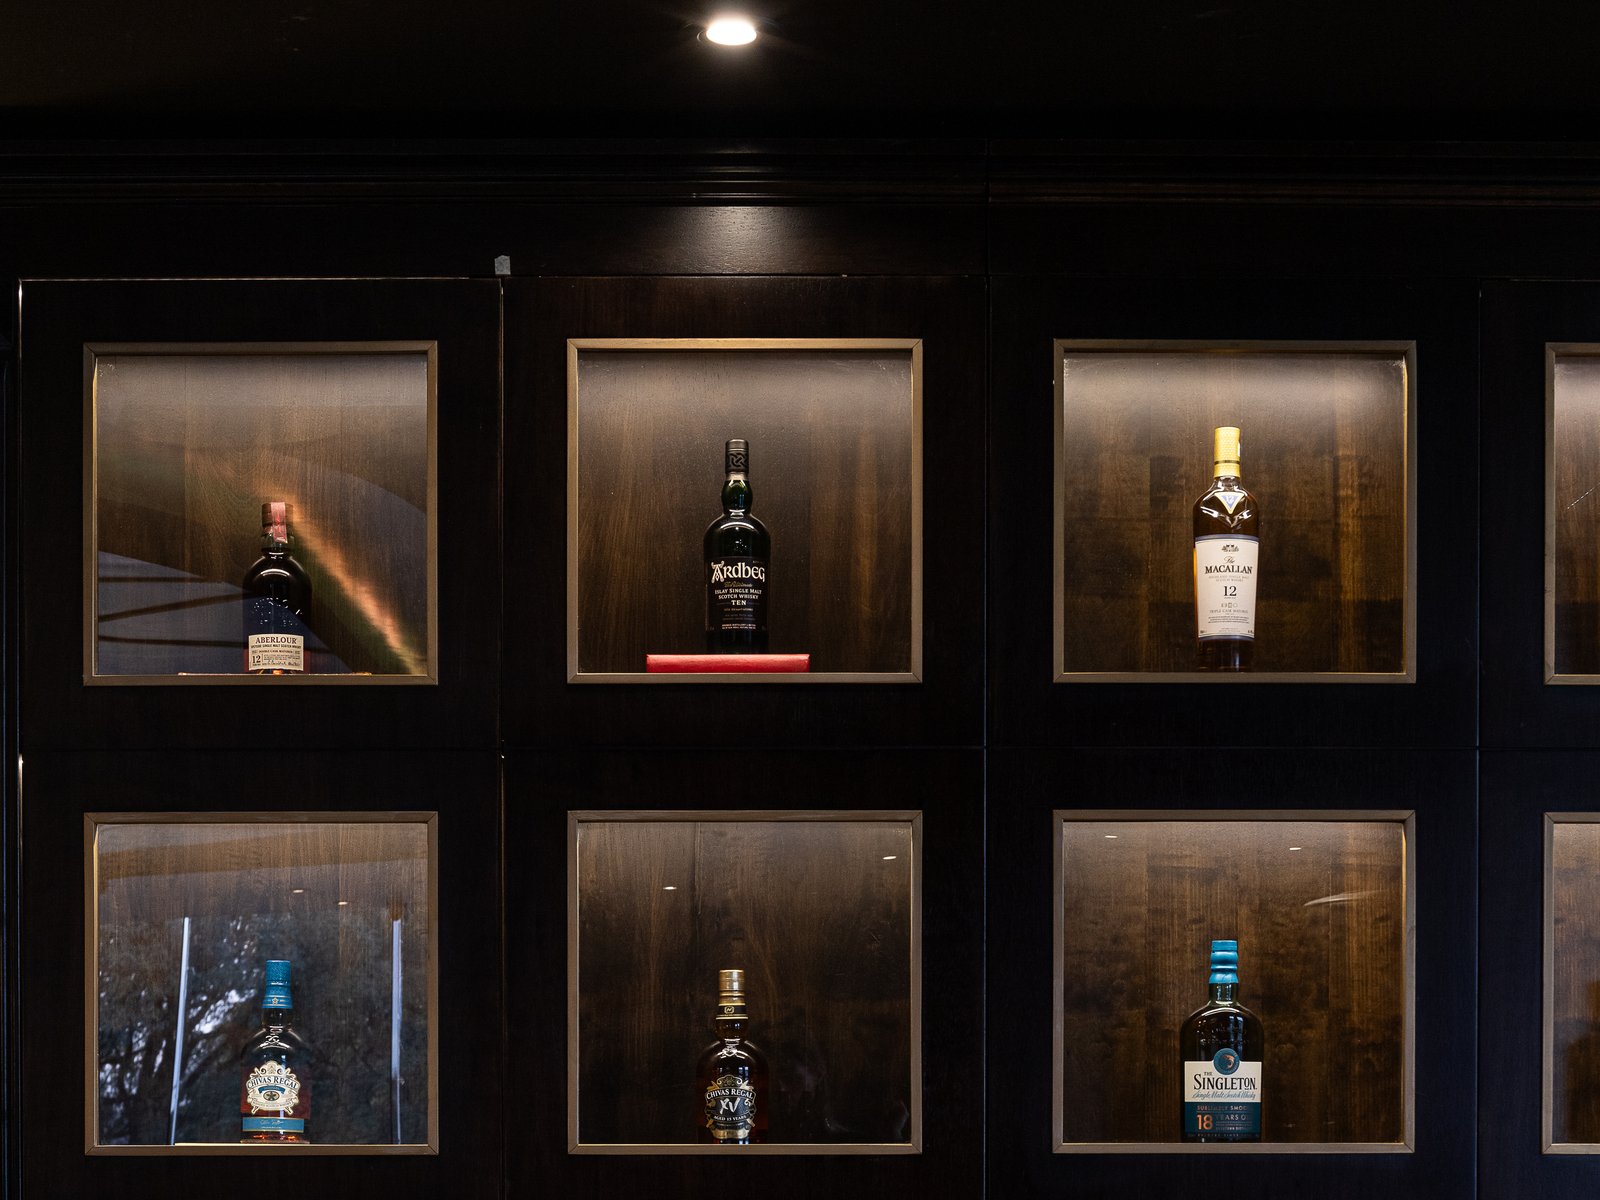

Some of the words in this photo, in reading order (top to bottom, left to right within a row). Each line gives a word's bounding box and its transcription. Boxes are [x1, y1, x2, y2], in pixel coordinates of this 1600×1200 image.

[1205, 565, 1253, 574] MACALLAN
[1224, 586, 1237, 597] 12
[255, 637, 297, 645] ABERLOUR
[252, 655, 261, 664] 12
[248, 1077, 272, 1088] CHIVAS
[273, 1076, 297, 1088] REGAL
[706, 1088, 730, 1100] CHIVAS
[731, 1088, 753, 1099] REGAL
[720, 1098, 740, 1114] XV
[1197, 1114, 1213, 1130] 18
